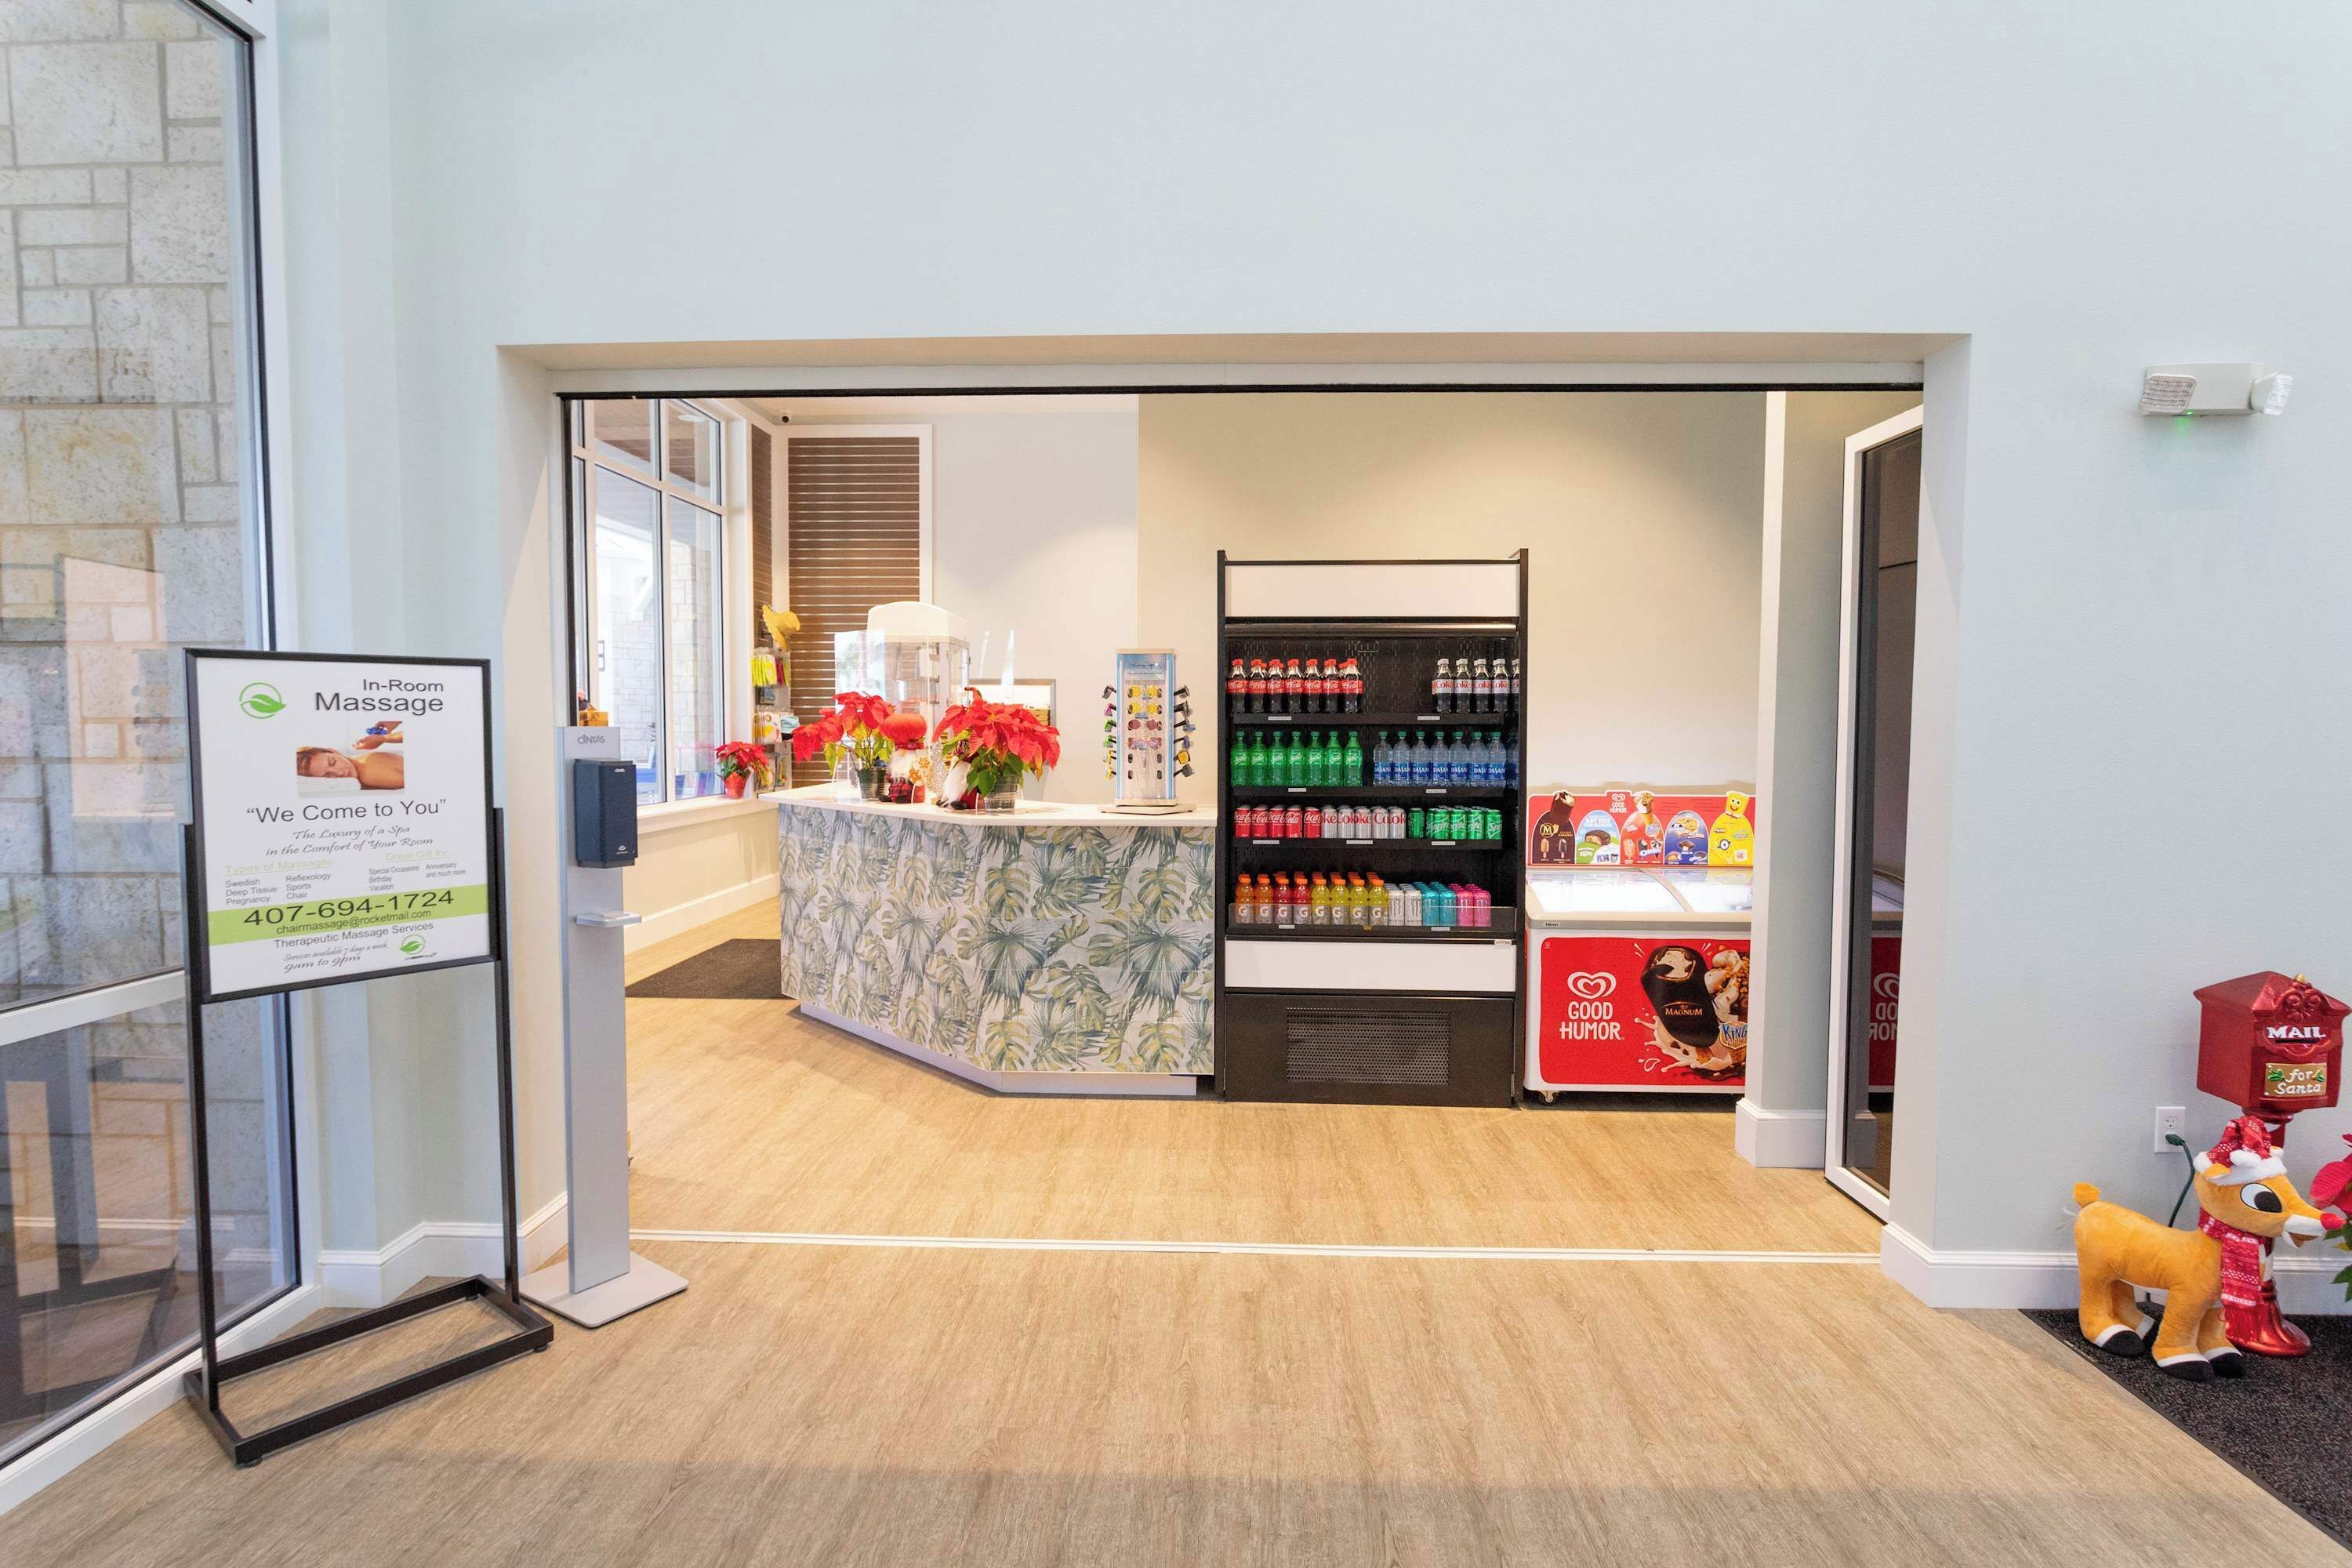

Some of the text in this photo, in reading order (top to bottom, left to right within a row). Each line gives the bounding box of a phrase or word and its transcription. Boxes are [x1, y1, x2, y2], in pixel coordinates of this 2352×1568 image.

[363, 679, 444, 692] In-Room
[315, 692, 444, 716] Massage
[578, 734, 605, 744] CINTAS
[303, 804, 367, 821] Come
[374, 802, 393, 817] to
[292, 829, 315, 840] The
[319, 829, 361, 840] Luxury
[364, 826, 377, 838] of
[388, 825, 410, 837] Spa
[281, 844, 299, 855] the
[303, 842, 351, 854] Comfort
[353, 840, 366, 851] of
[368, 840, 397, 850] Your
[400, 837, 434, 847] Room
[368, 865, 419, 876] Special Occasions
[225, 879, 260, 888] Swedish
[285, 873, 332, 883] Reflexology
[225, 886, 278, 898] Deep Tissue
[285, 883, 312, 891] Sports
[226, 895, 270, 906] Pregnancy
[285, 891, 307, 900] Chair
[244, 890, 454, 926] 407-694-1724
[276, 909, 432, 935] chairmassage@rocketmail.com
[274, 921, 434, 949] Therapeutic Massage Services
[284, 961, 314, 973] 9am
[332, 955, 361, 967] 9pm
[1568, 1001, 1613, 1019] GOOD
[1665, 1007, 1703, 1016] MAGNUM
[1559, 1022, 1621, 1040] HUMOR
[2267, 1026, 2326, 1039] MAIL
[2285, 1069, 2313, 1083] for
[2274, 1083, 2321, 1095] Santa
